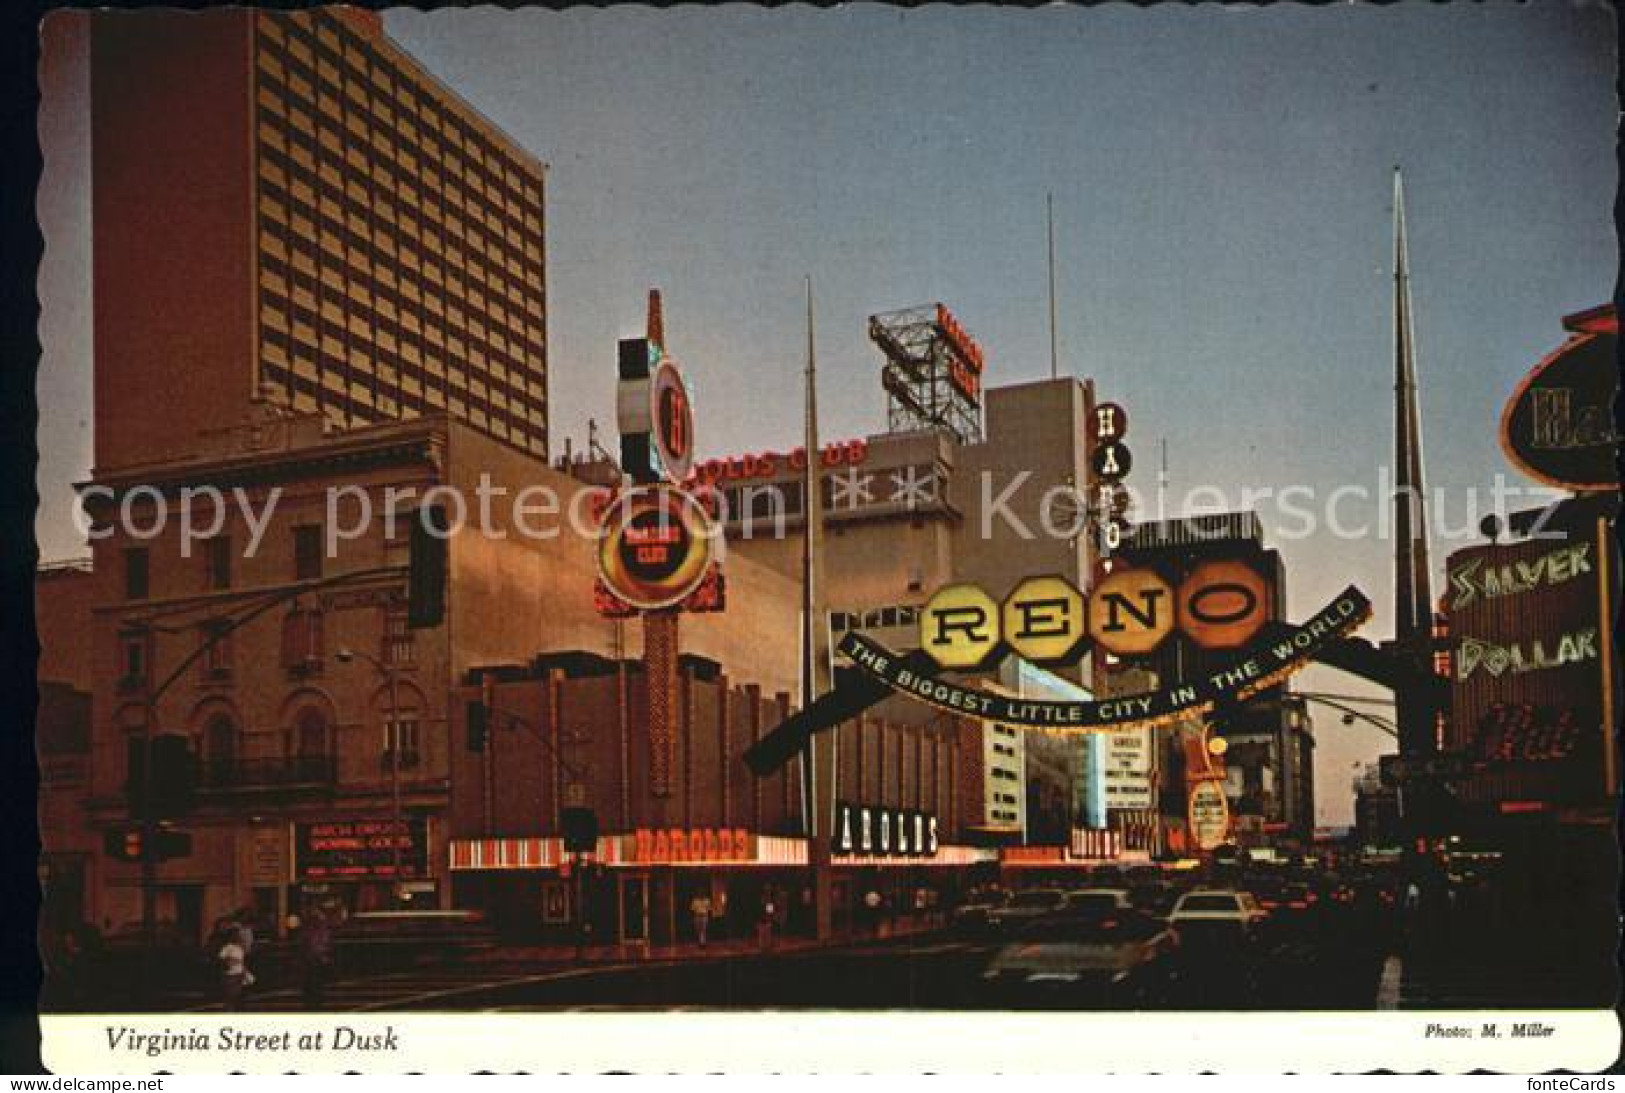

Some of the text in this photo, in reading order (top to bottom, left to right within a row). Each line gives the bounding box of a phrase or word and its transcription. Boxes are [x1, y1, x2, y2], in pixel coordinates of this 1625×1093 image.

[788, 438, 866, 472] CUB
[931, 583, 1258, 645] RENO
[850, 599, 1354, 723] THE BIGGEST LITTLE CITY IN THE WORLD
[842, 806, 938, 852] AROLDS
